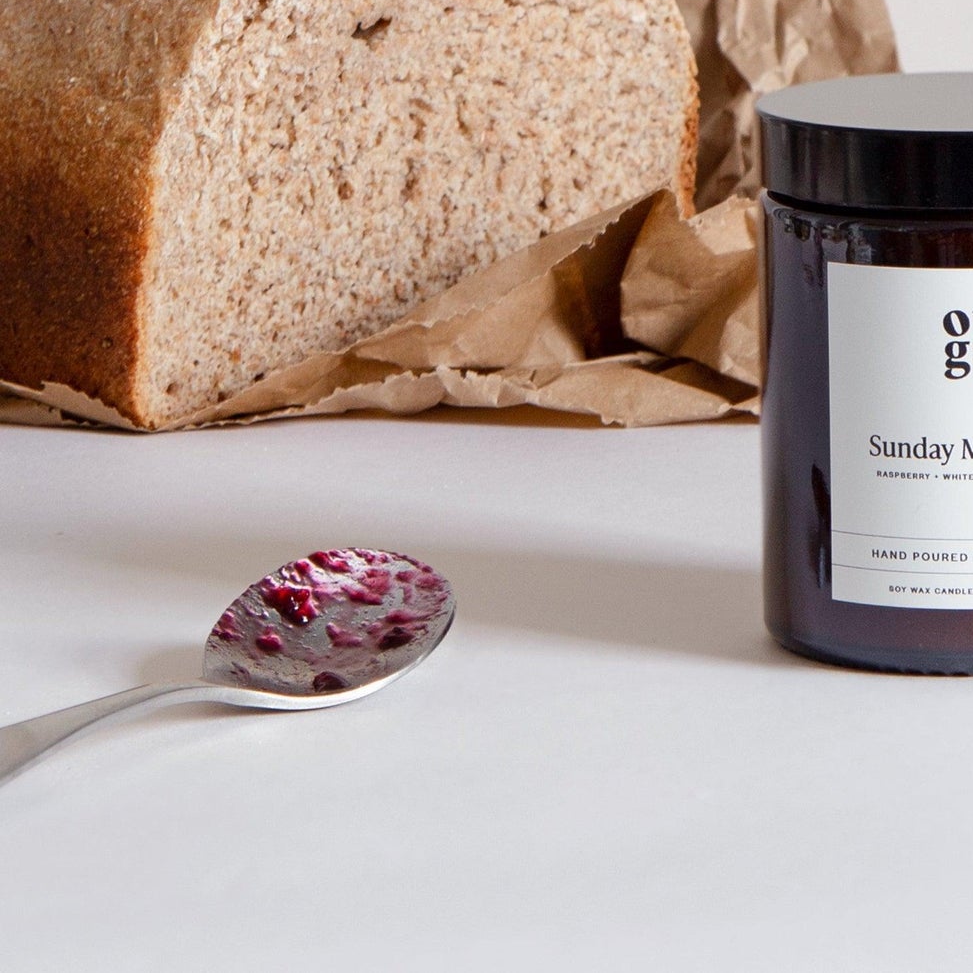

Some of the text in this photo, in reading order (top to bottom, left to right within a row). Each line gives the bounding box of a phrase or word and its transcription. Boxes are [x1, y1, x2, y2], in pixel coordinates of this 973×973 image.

[869, 434, 955, 466] Sunday
[876, 469, 931, 481] RASPBERRY
[871, 548, 908, 561] HAND
[912, 551, 969, 563] POURED
[888, 585, 907, 594] SOY
[909, 585, 931, 595] WAX
[934, 586, 973, 596] CANDLE
